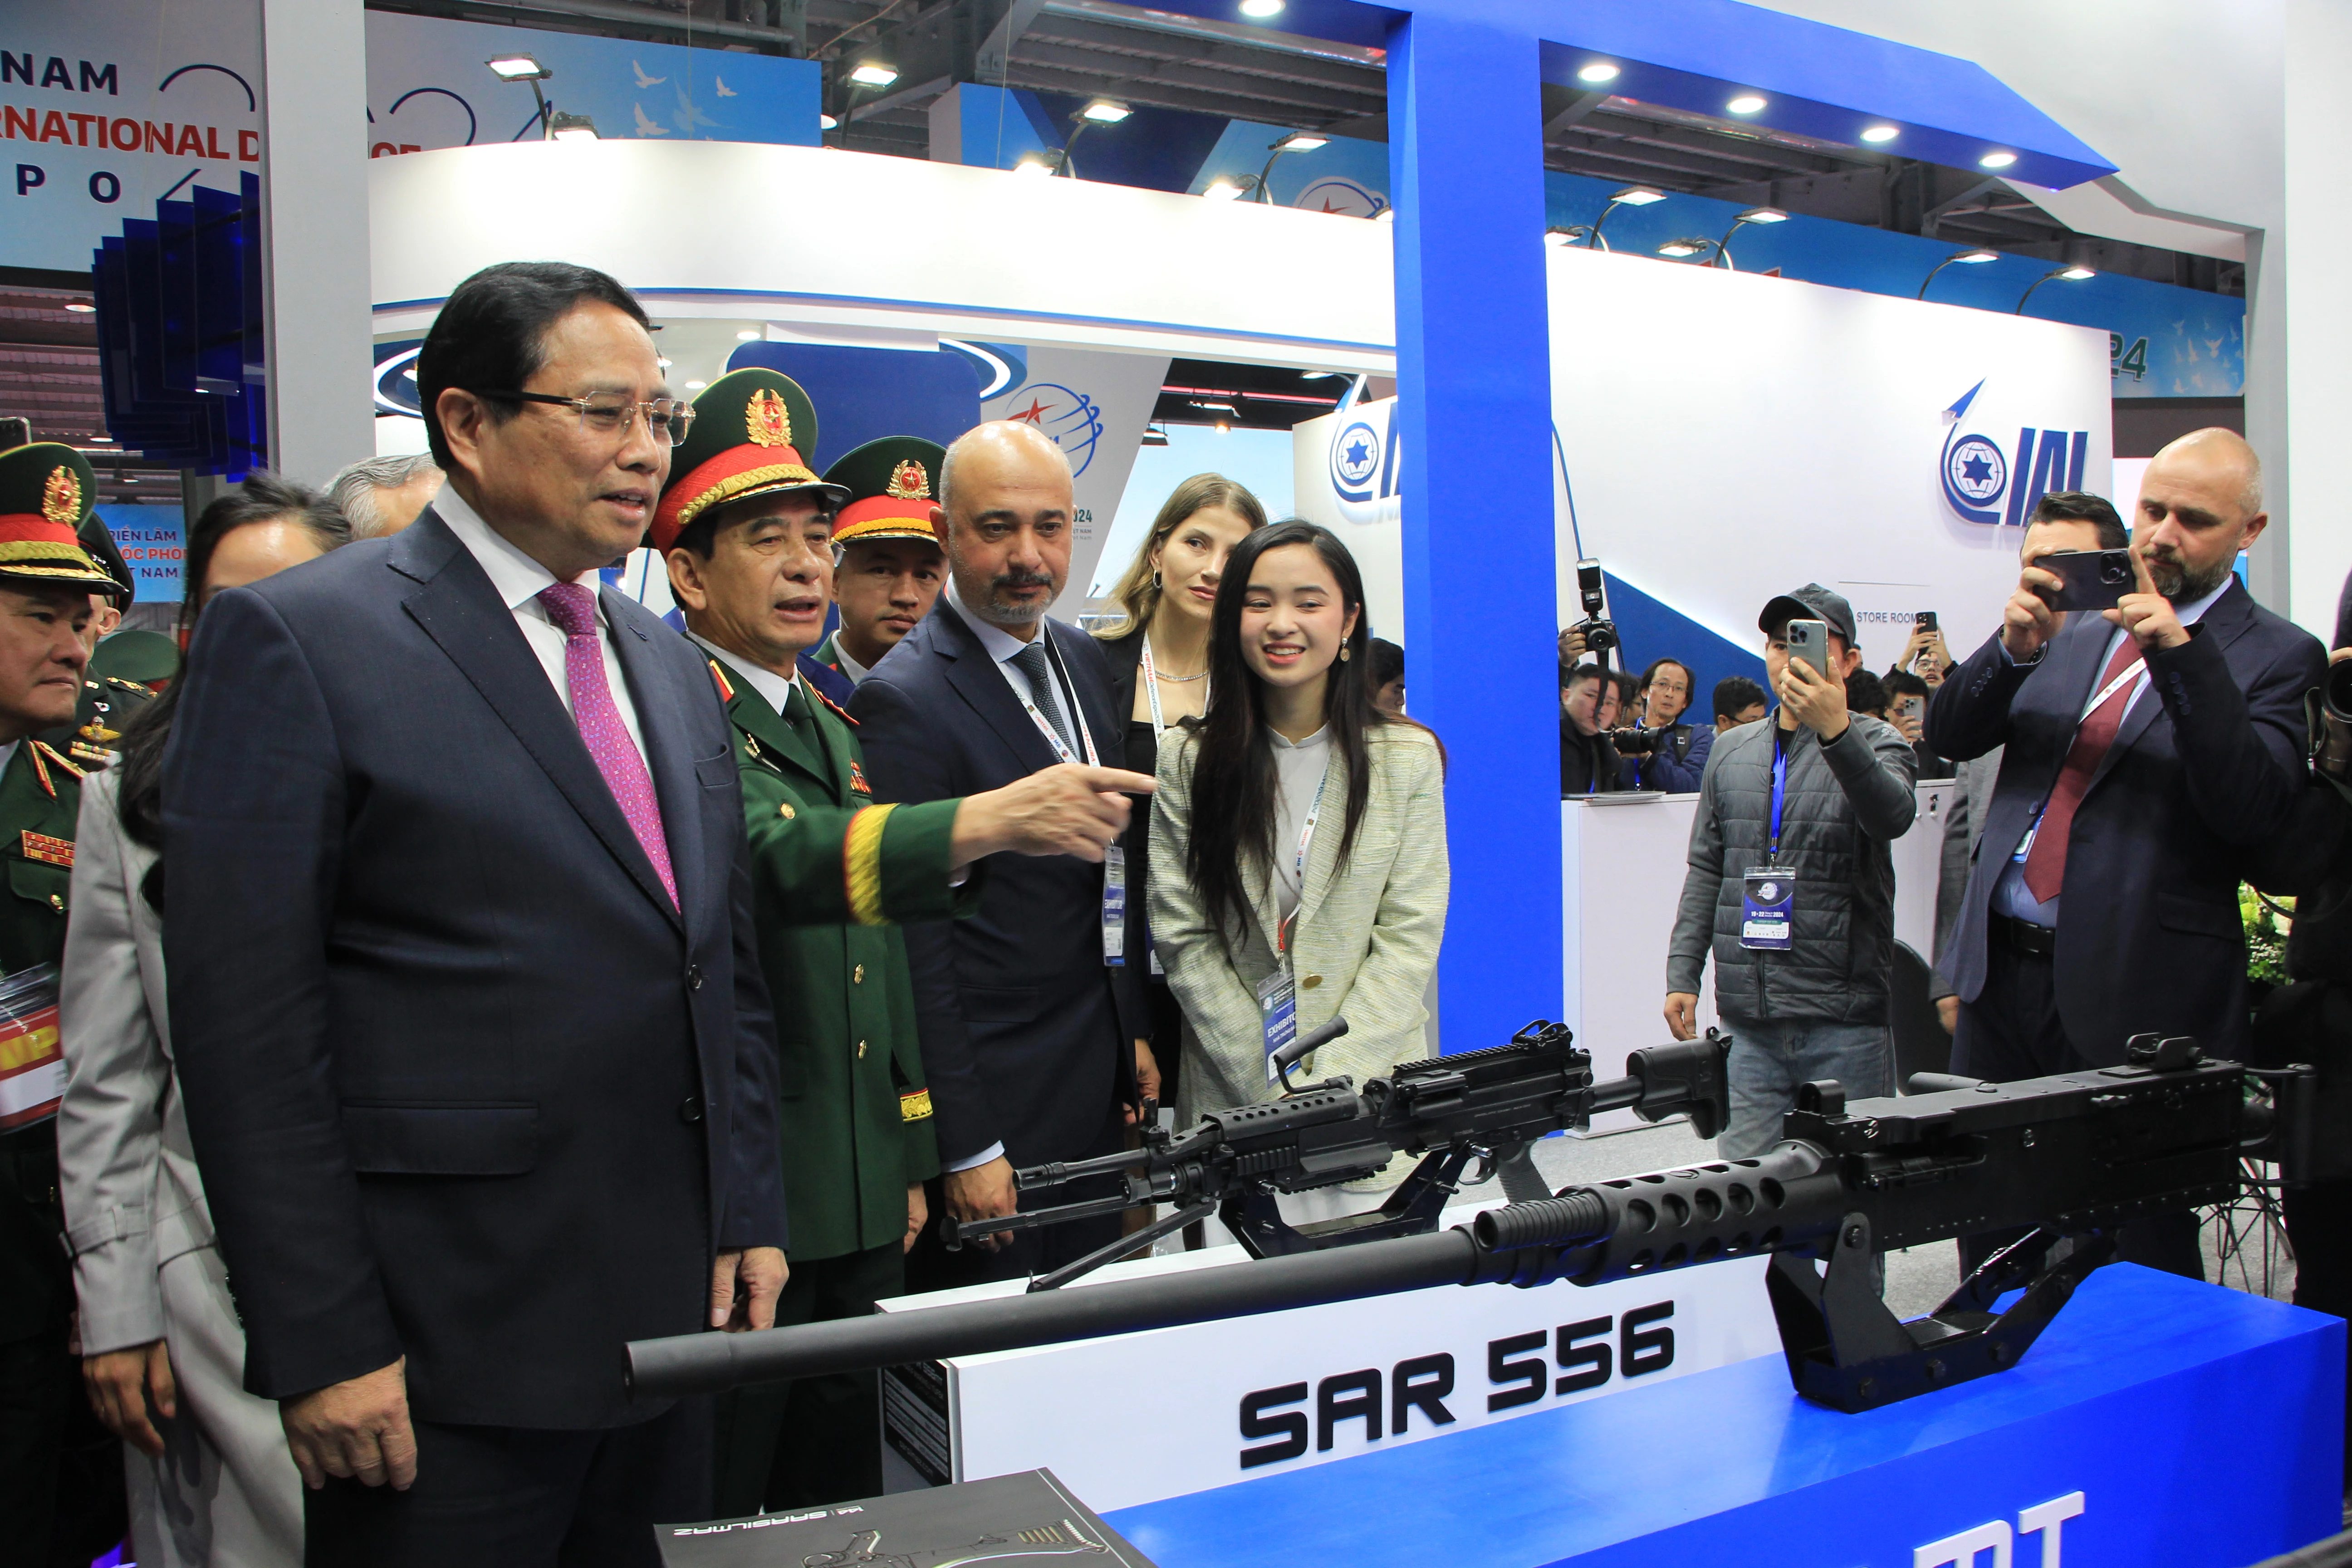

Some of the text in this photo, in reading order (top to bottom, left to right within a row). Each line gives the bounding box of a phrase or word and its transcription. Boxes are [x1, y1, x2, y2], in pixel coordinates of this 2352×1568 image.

[2111, 333, 2148, 380] 24
[1073, 509, 1092, 522] 024
[109, 525, 141, 541] RIỂN
[121, 544, 187, 559] ỐC PHÒ
[142, 568, 178, 578] NAM
[1857, 611, 1887, 622] STORE
[1240, 1300, 1674, 1469] SAR 556
[673, 1510, 828, 1536] SARSILMAZ
